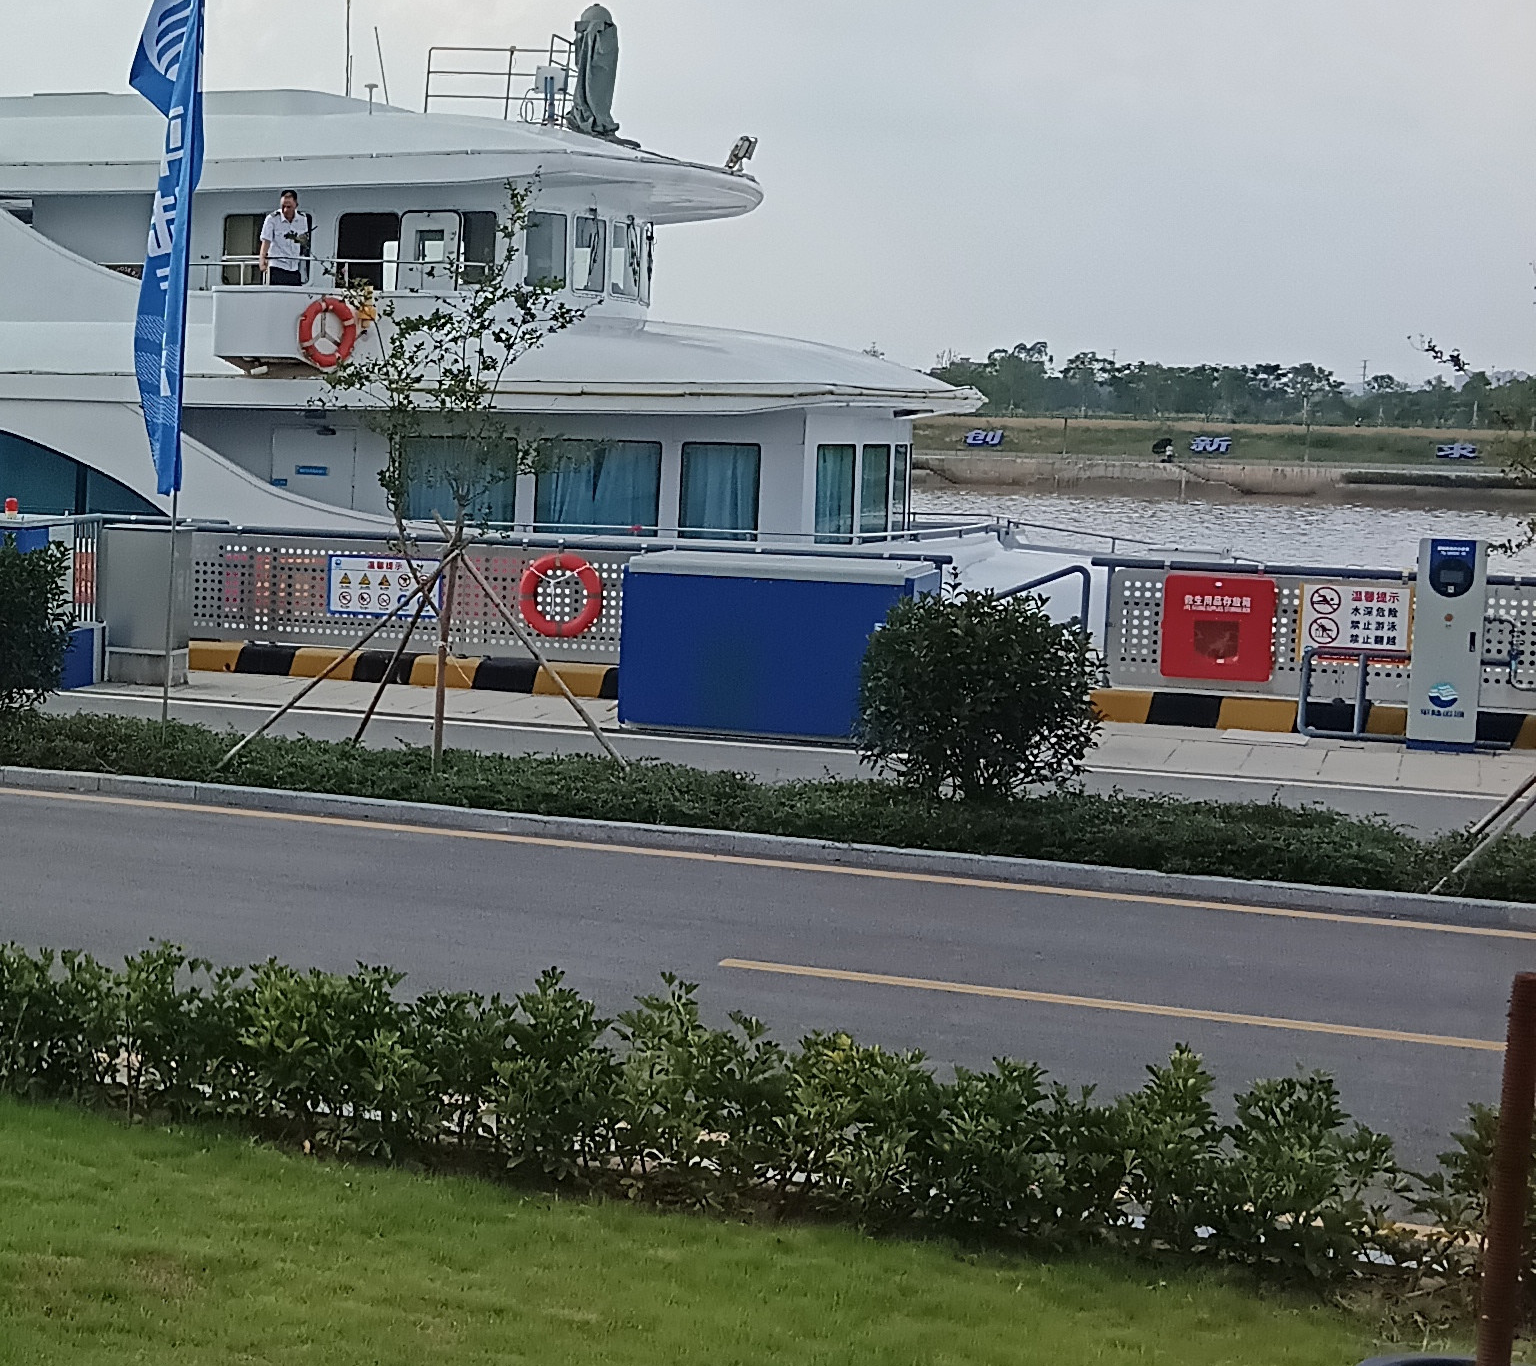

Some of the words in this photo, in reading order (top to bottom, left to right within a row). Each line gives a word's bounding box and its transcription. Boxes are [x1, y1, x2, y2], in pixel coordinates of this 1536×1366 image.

[1351, 590, 1400, 603] 温馨提示
[1350, 606, 1399, 618] 水深危险
[1350, 620, 1397, 632] 禁止游泳
[1349, 634, 1397, 646] 禁止翻越
